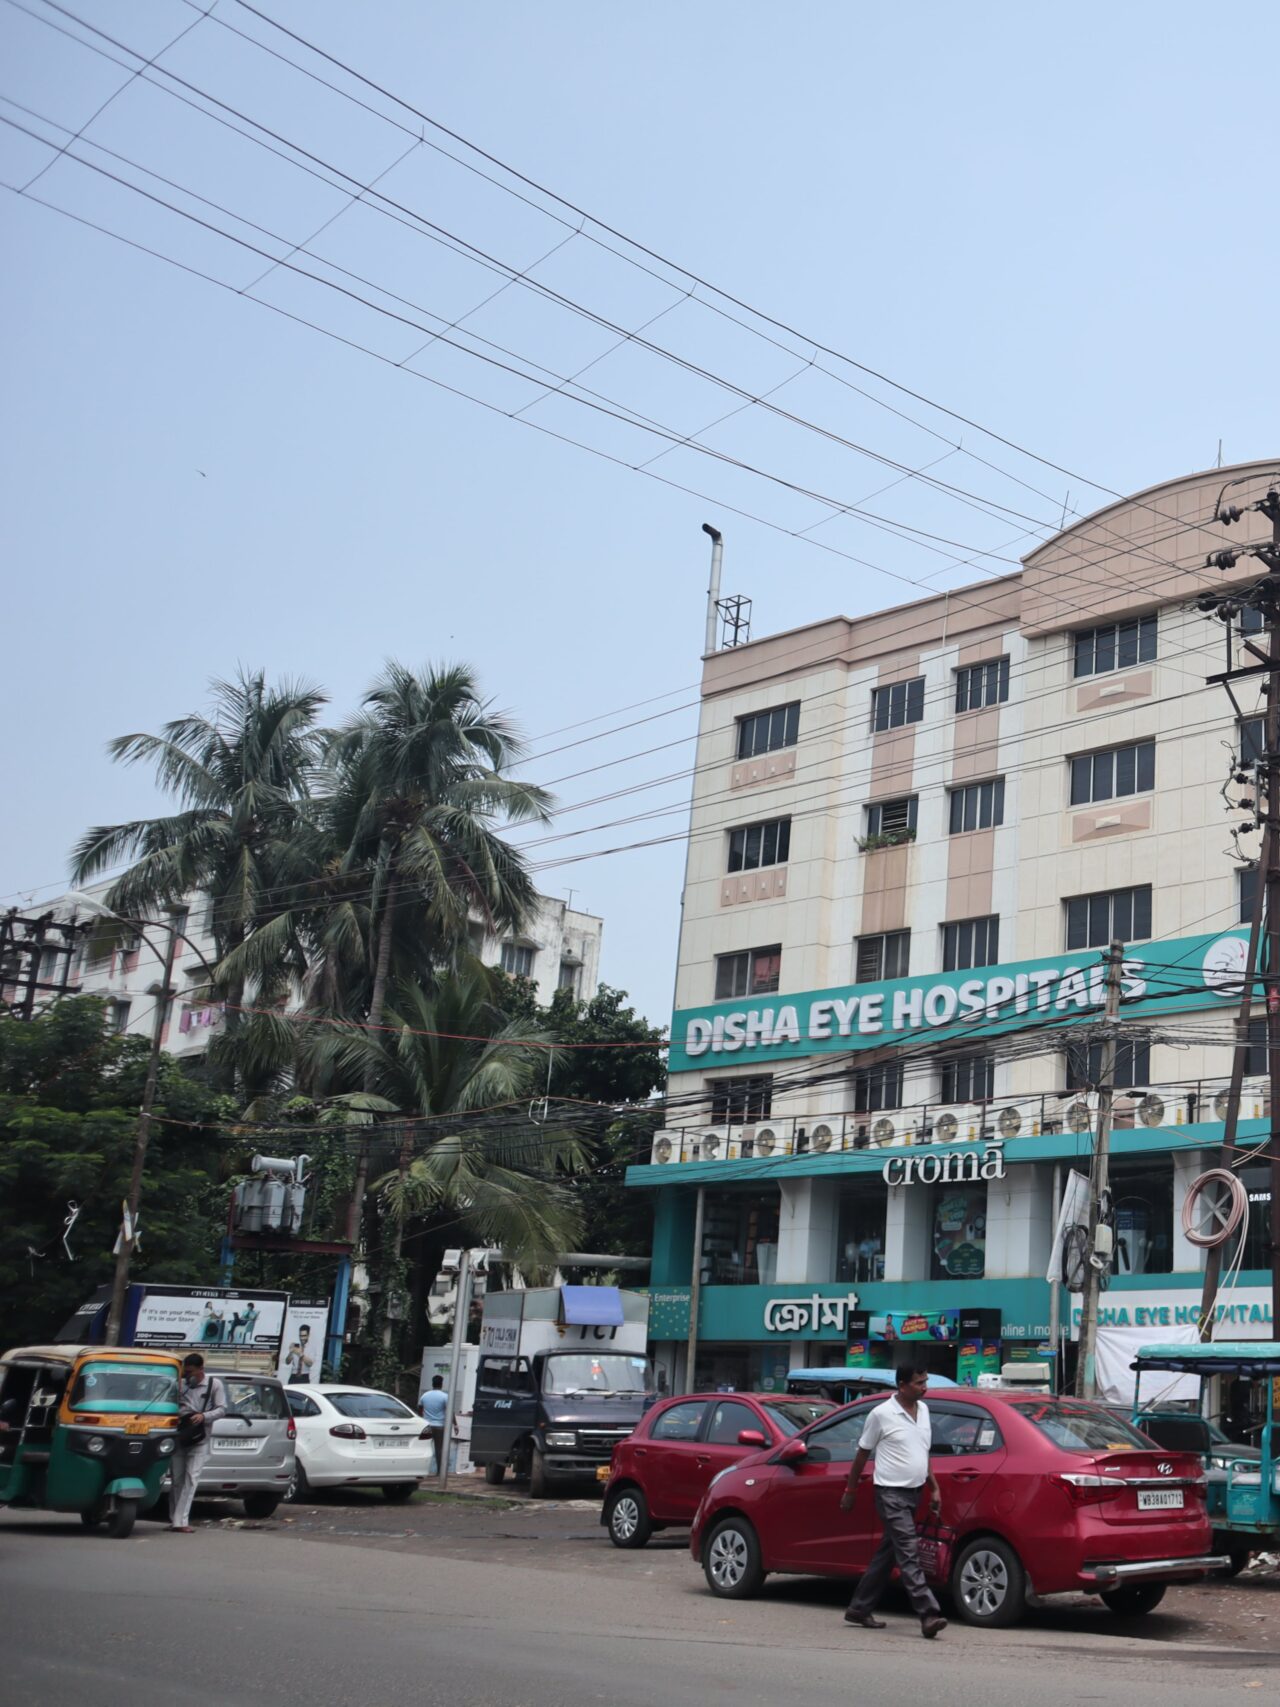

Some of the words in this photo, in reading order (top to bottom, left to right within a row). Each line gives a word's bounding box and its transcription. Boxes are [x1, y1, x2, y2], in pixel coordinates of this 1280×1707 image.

[686, 1005, 799, 1056] DISHA
[809, 994, 885, 1039] EYE
[893, 959, 1147, 1030] HOSPITALS
[654, 1293, 691, 1303] Enterprise
[1072, 1307, 1131, 1327] DSHA
[1135, 1306, 1171, 1326] EYE
[1001, 1323, 1025, 1336] nline
